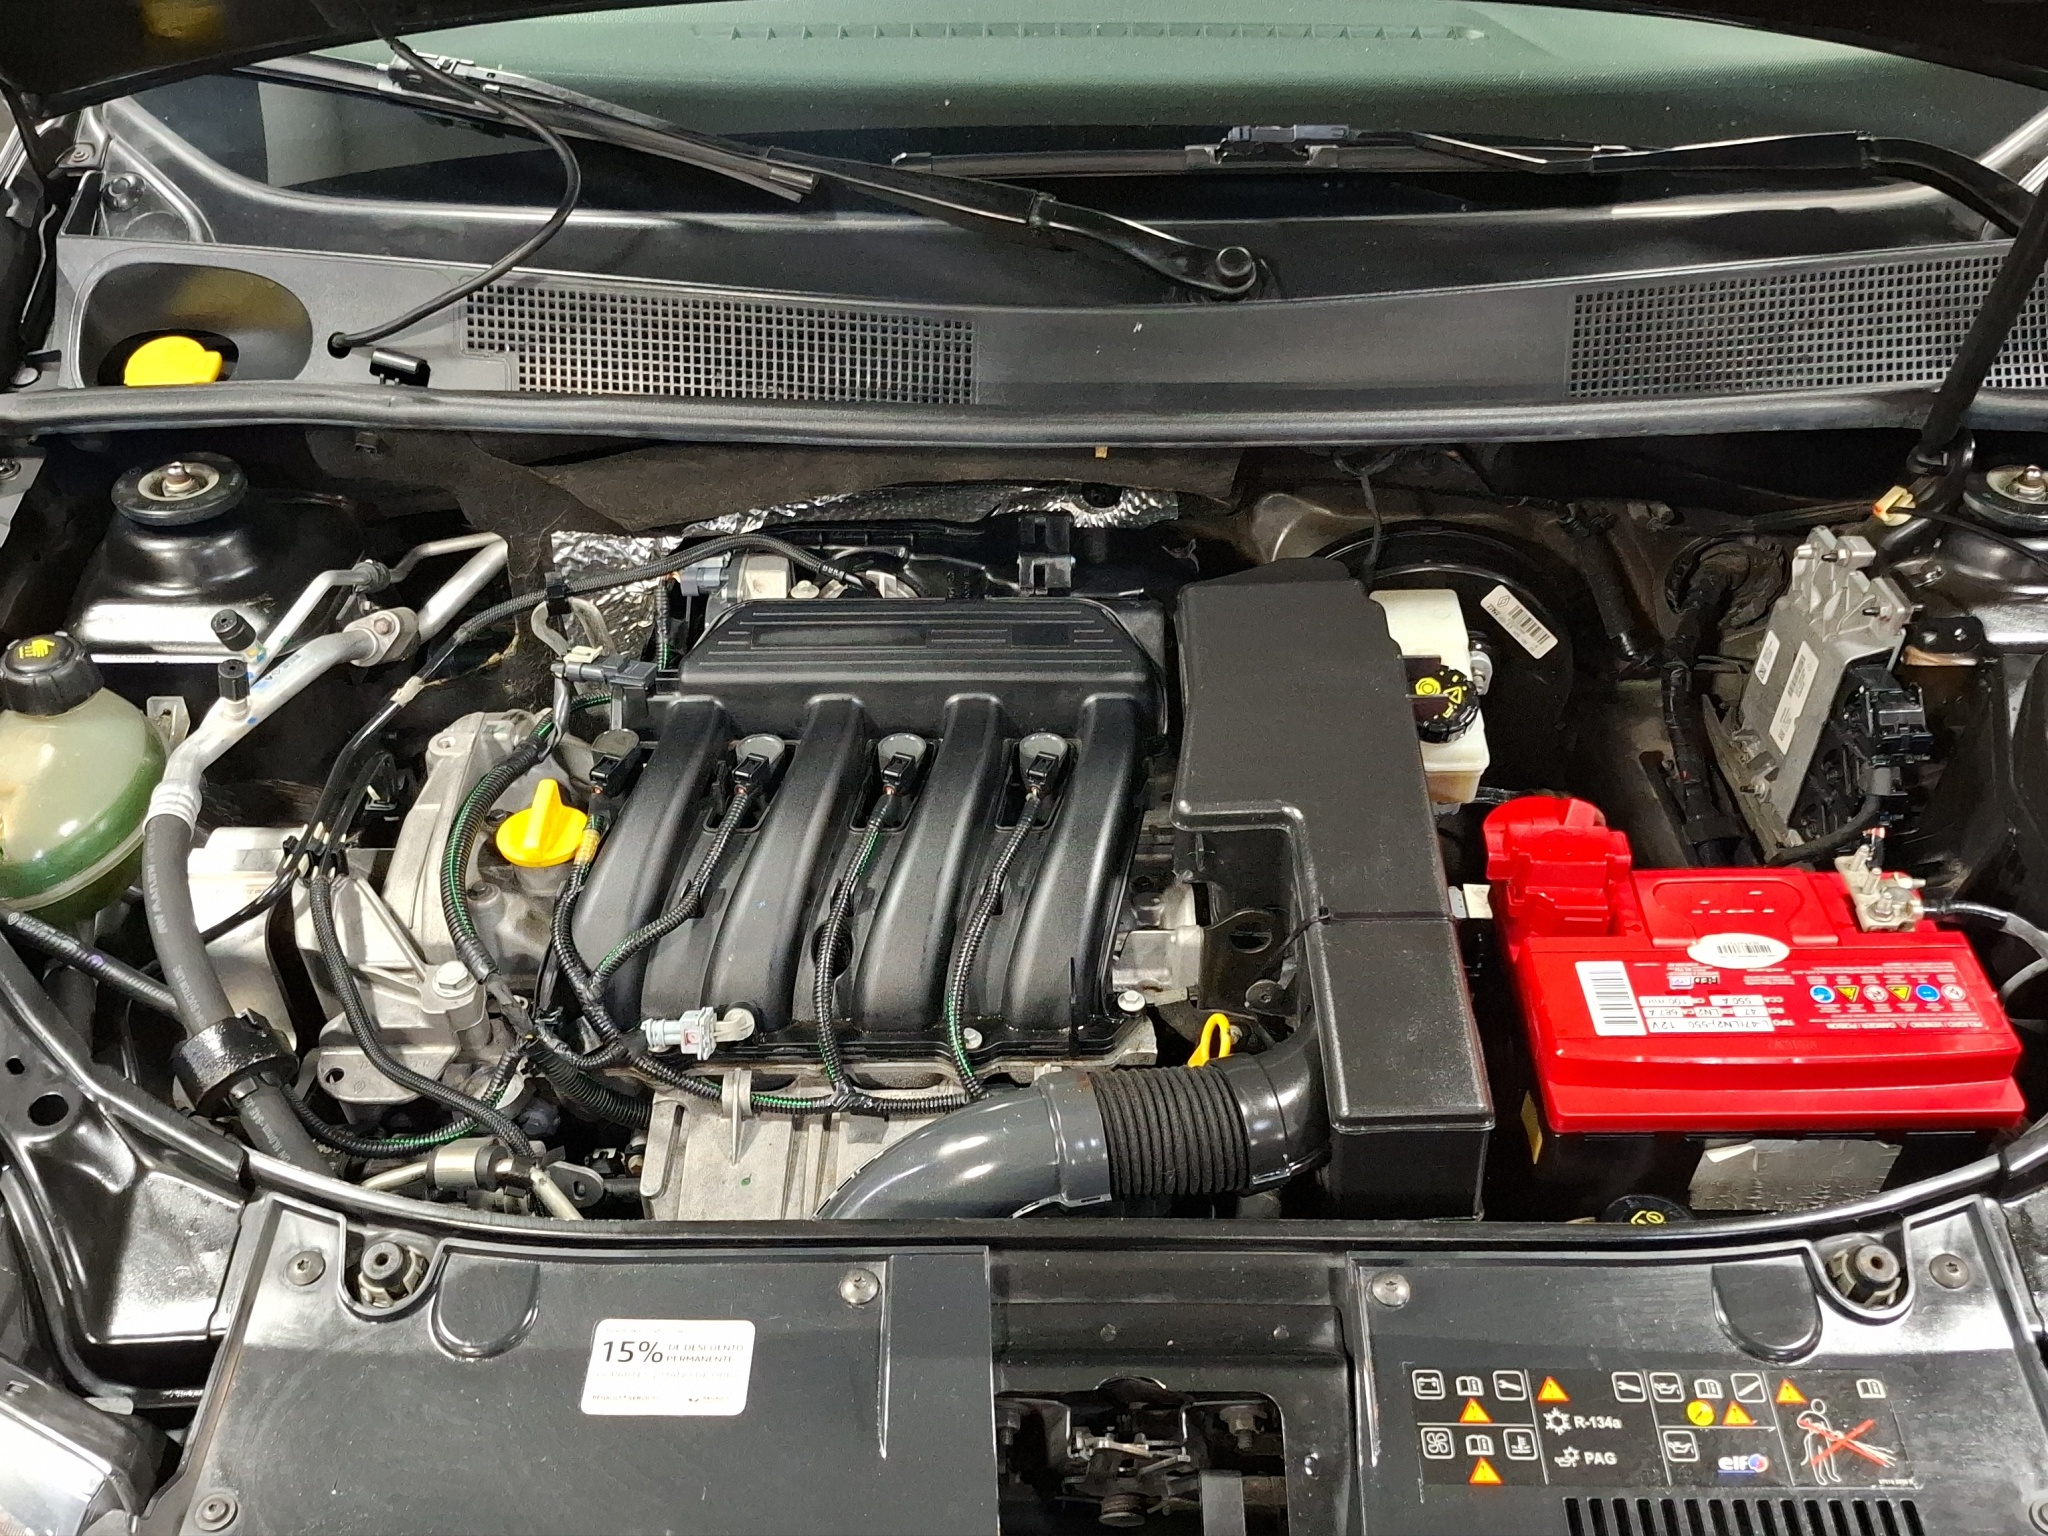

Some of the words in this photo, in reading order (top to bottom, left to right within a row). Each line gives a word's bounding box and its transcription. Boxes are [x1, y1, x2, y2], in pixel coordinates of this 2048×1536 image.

[1652, 1021, 1675, 1029] 12V
[603, 1341, 663, 1363] 15%
[666, 1355, 733, 1363] PERMANENTE
[1573, 1415, 1622, 1429] R-134a
[1583, 1451, 1618, 1465] PAG
[1718, 1455, 1749, 1471] elf
